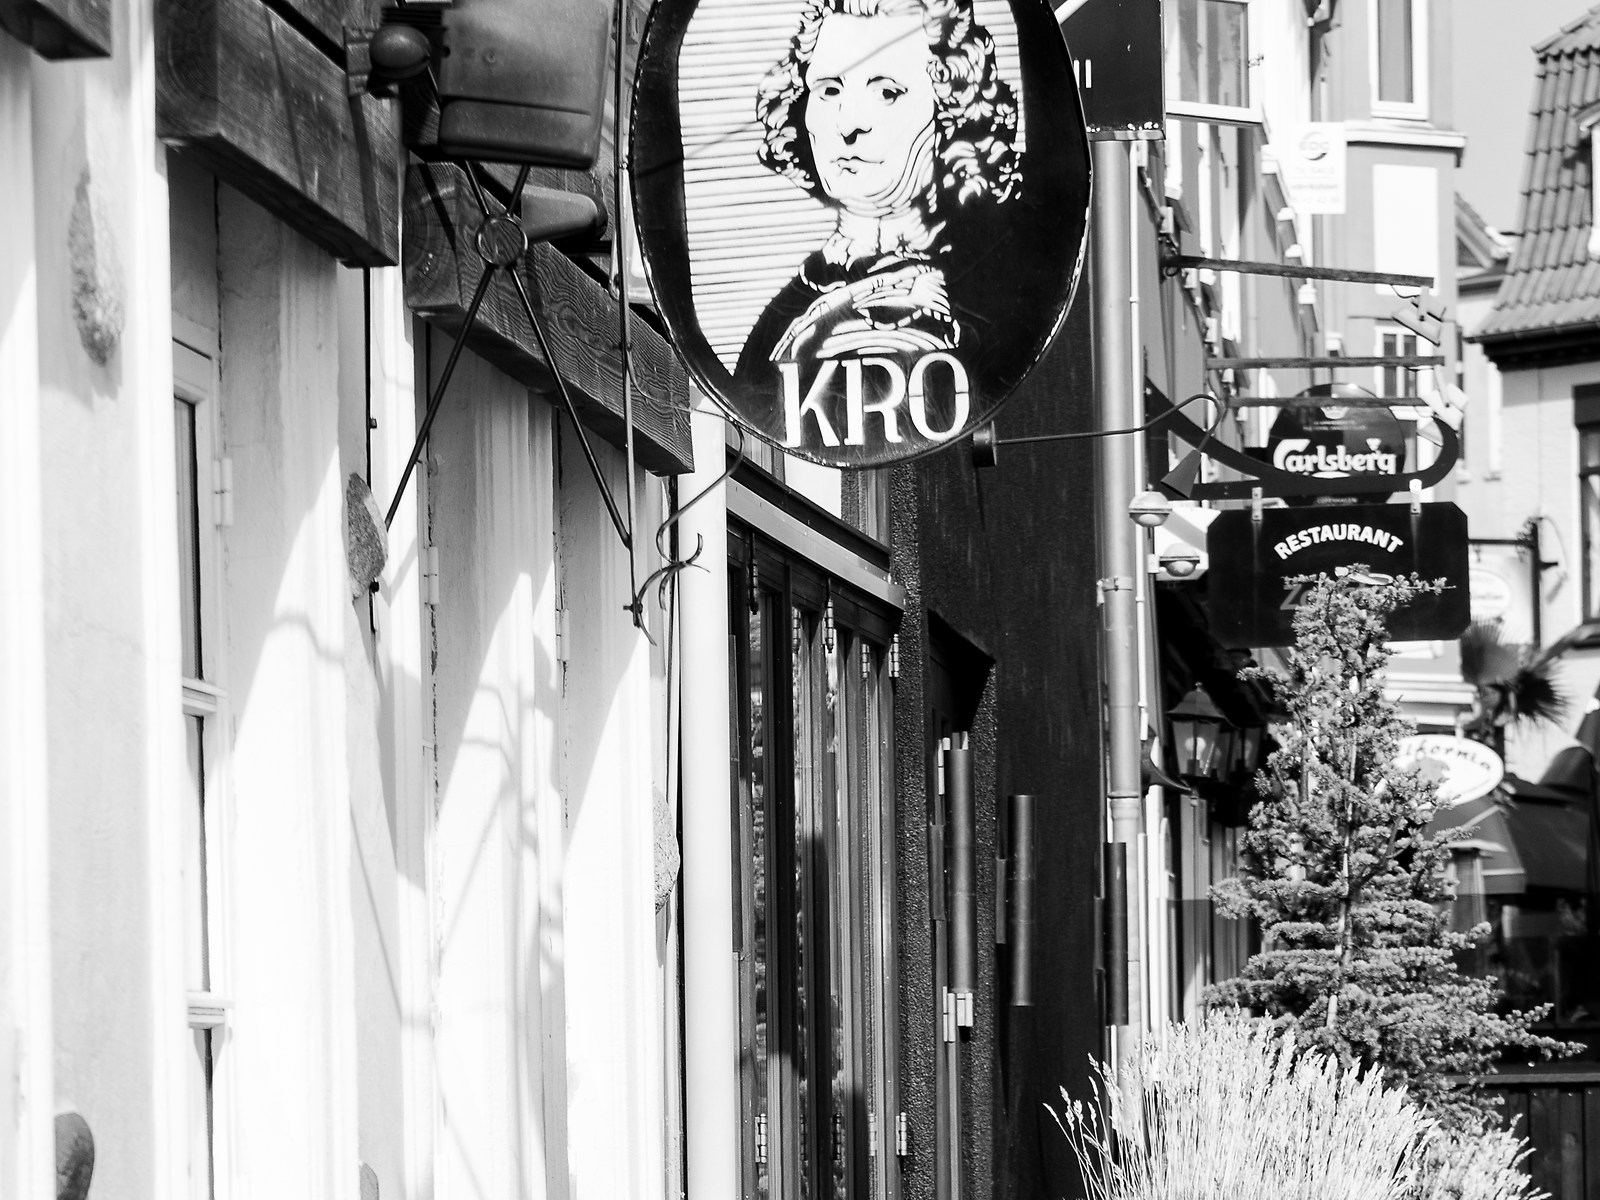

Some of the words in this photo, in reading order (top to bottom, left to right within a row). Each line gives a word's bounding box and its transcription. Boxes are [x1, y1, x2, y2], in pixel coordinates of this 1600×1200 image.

[778, 352, 970, 448] KRO
[1273, 438, 1397, 475] Carlsberg
[1274, 524, 1403, 560] RESTAURANT
